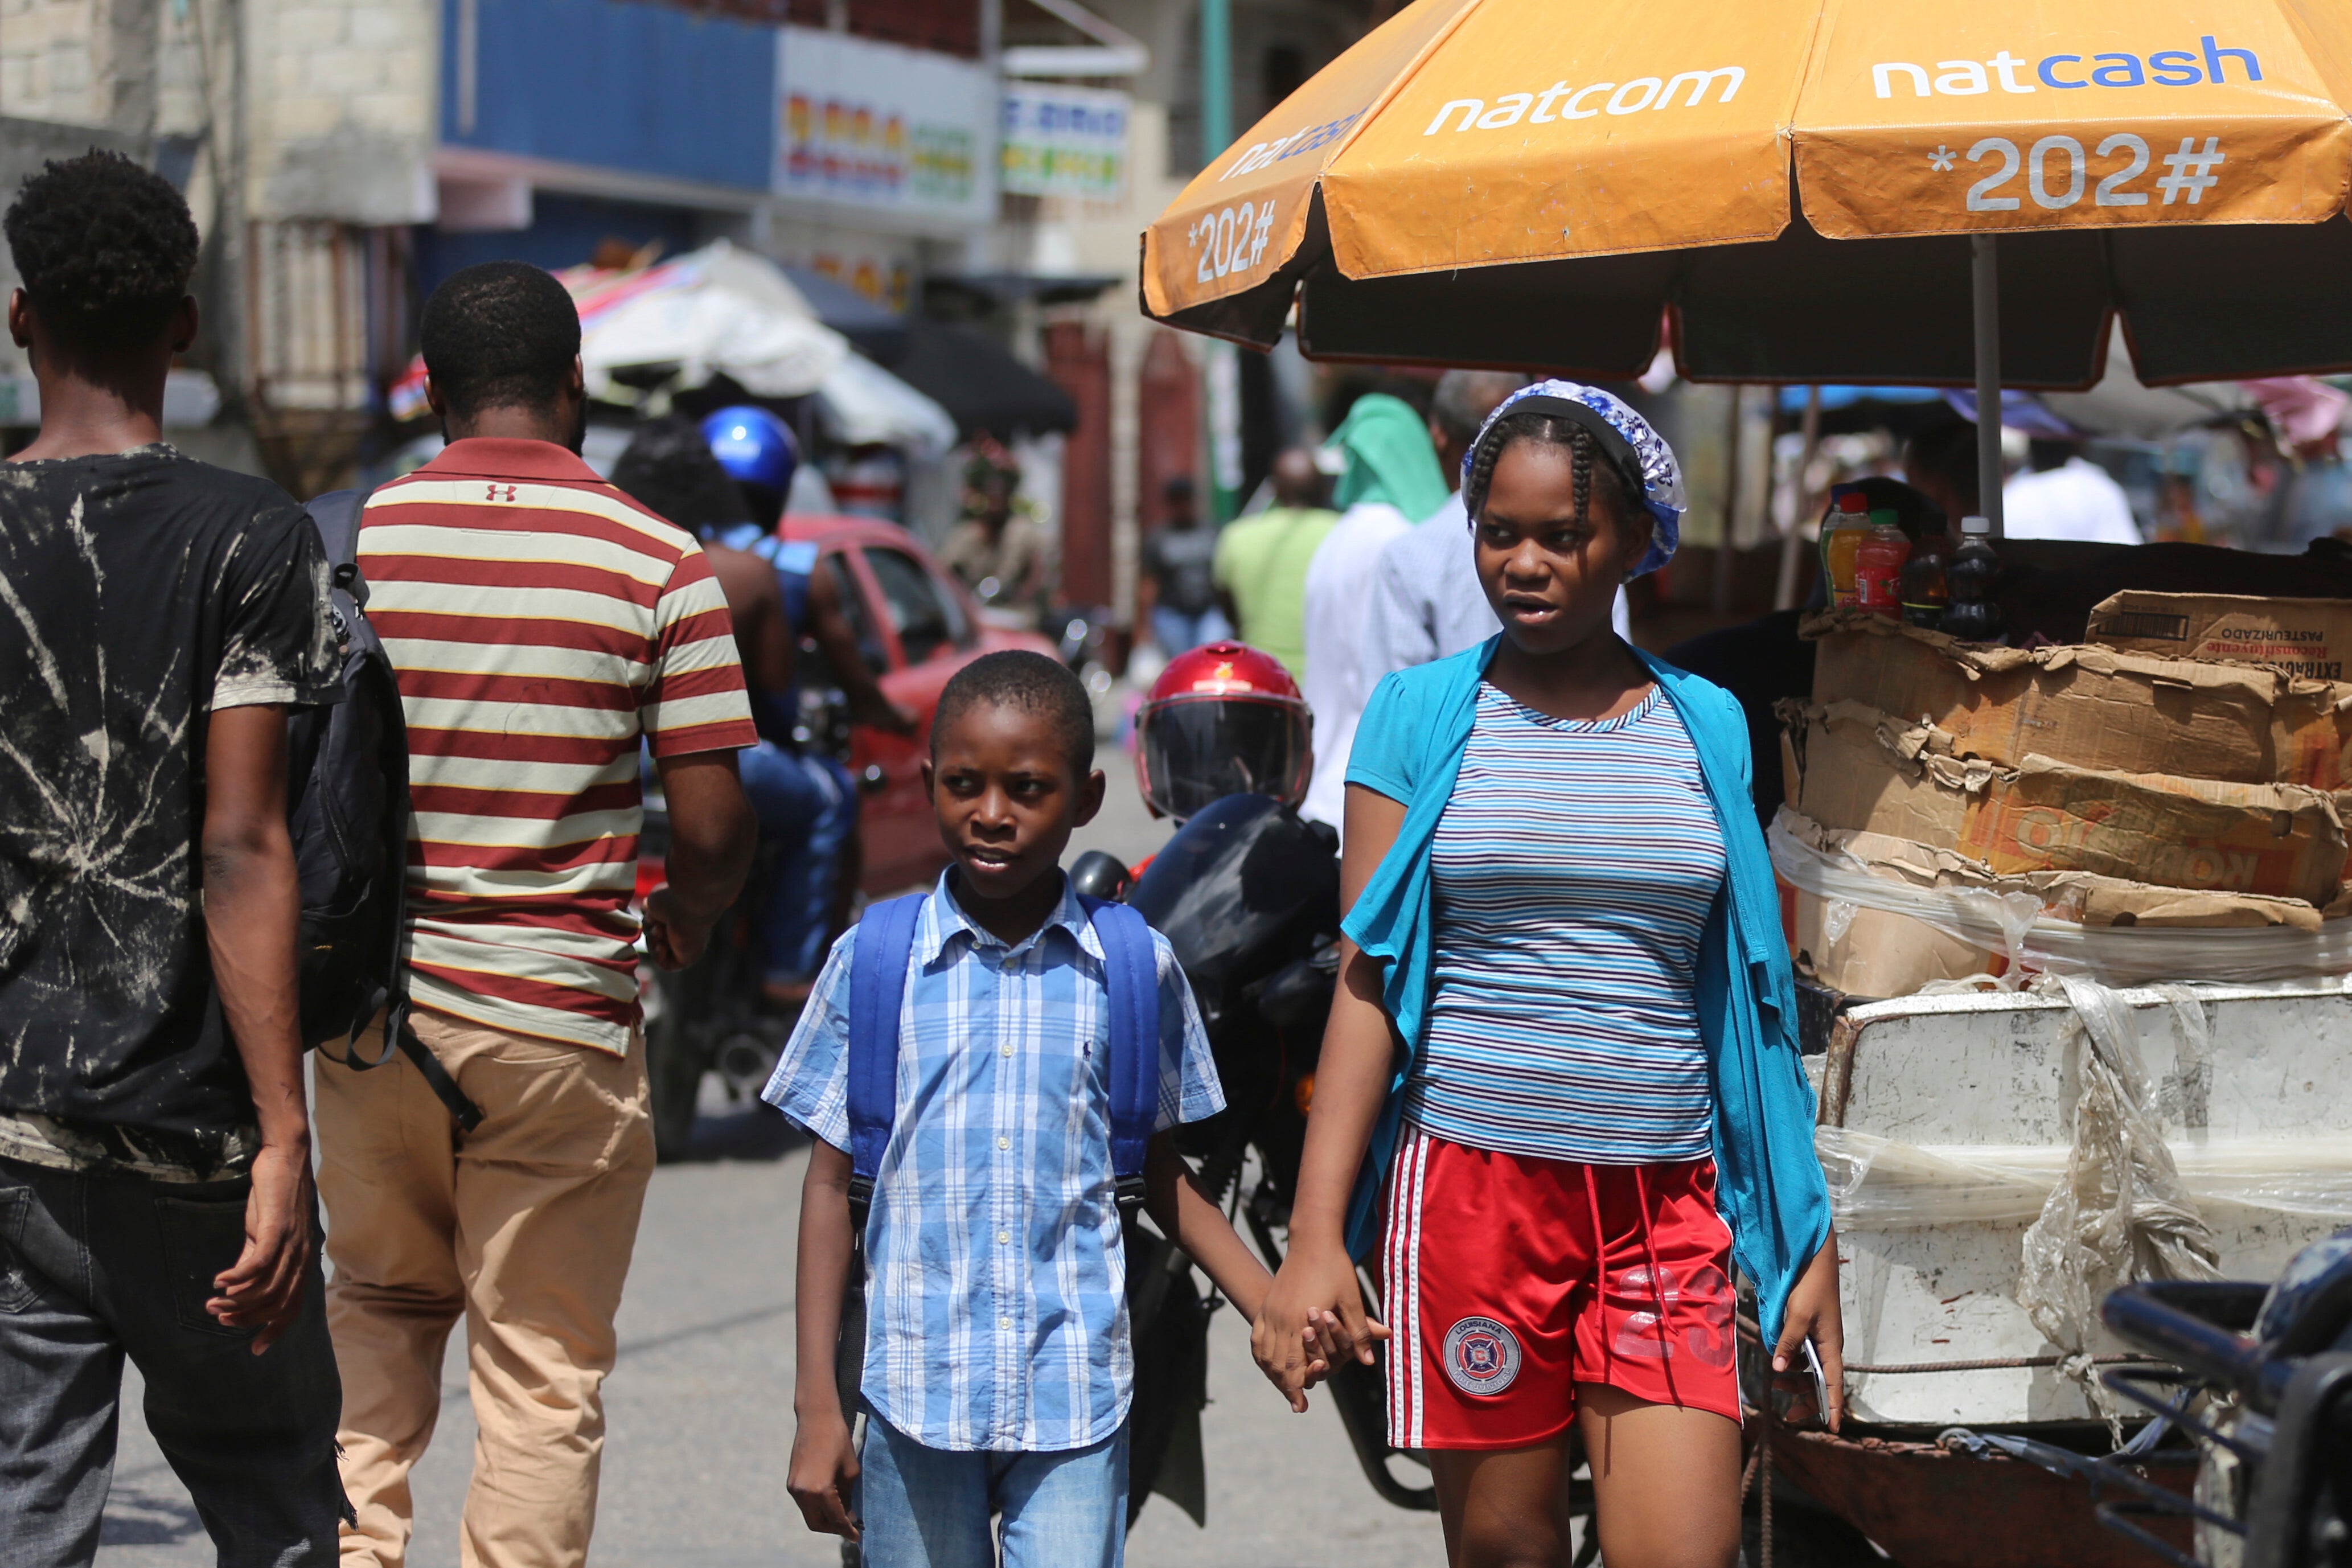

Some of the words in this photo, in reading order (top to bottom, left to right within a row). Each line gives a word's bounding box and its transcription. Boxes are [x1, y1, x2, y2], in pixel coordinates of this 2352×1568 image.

[1872, 35, 2263, 98] natcash
[1423, 65, 1746, 137] natcom
[2222, 627, 2324, 642] PASTEURIZADO
[2206, 642, 2328, 660] Reconstituyente
[2268, 661, 2342, 680] EXTRAC
[1614, 1265, 1735, 1368] 23
[1456, 1321, 1501, 1335] LOUISIANA
[1473, 1368, 1513, 1390] JUNIORS
